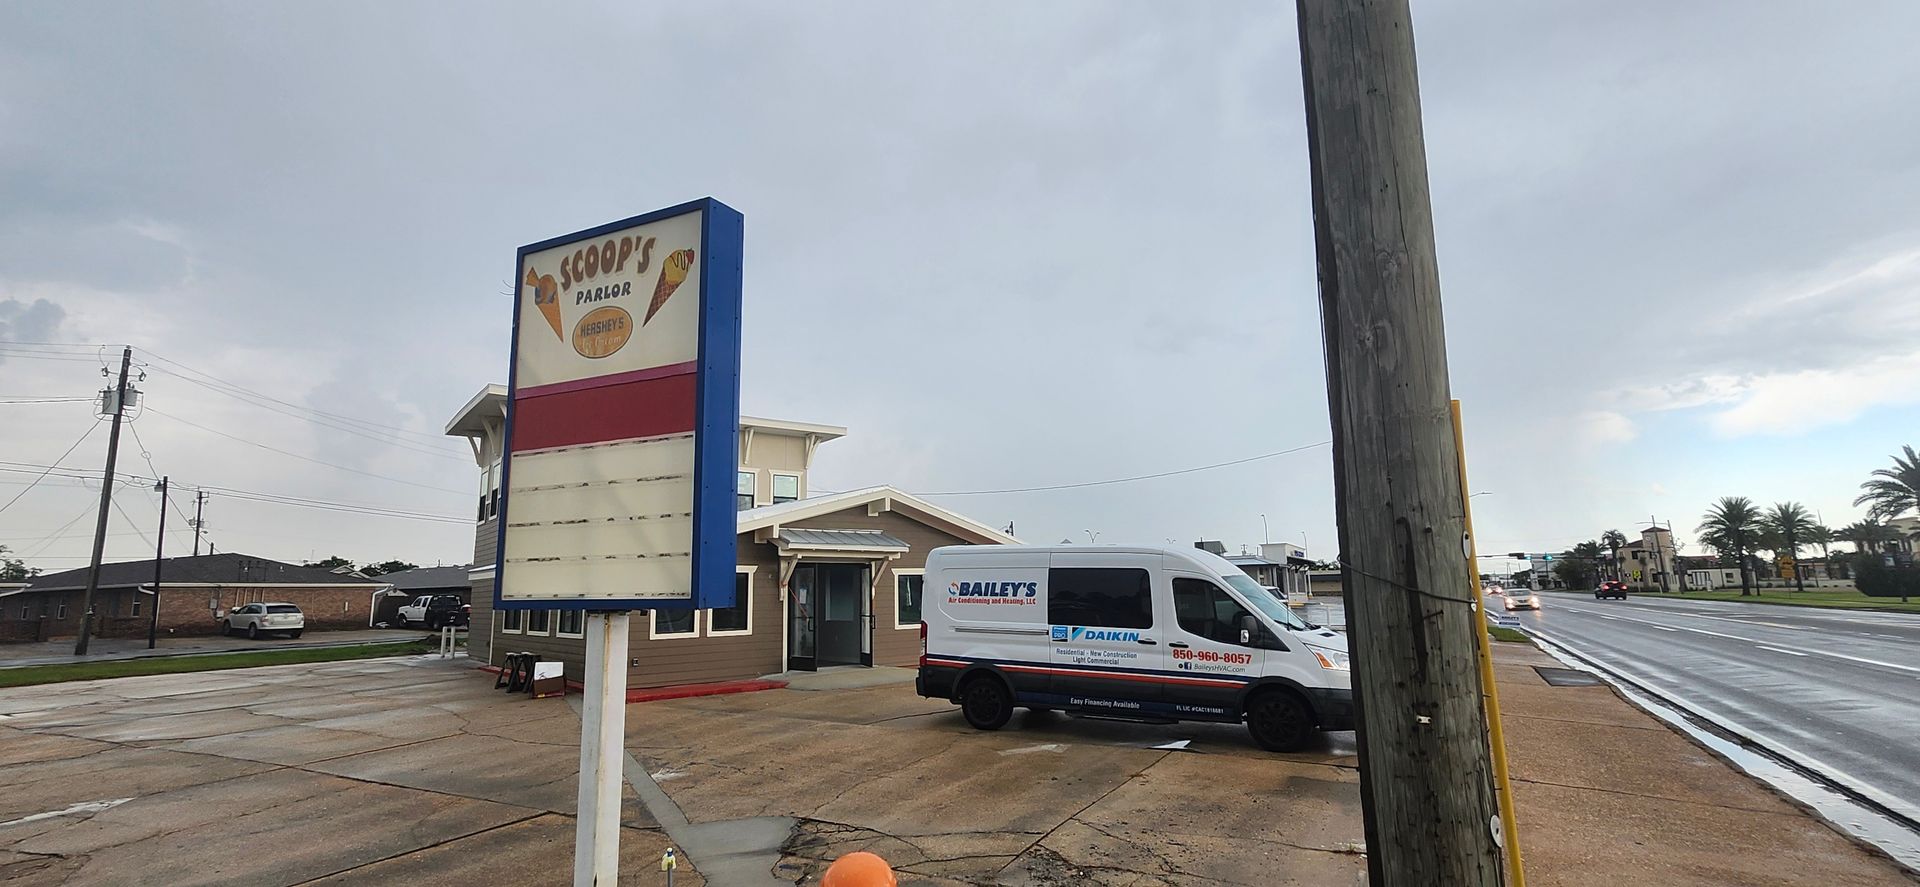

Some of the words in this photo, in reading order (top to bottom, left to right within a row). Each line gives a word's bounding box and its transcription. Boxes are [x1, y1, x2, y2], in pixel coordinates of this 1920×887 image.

[560, 236, 656, 292] SCOOP'S
[576, 281, 631, 305] PARLOR
[580, 316, 624, 337] HERSHEYS
[959, 582, 1037, 597] BAILEY'S
[1085, 631, 1139, 641] DAIKIN
[1056, 648, 1086, 657] Residential
[1103, 650, 1137, 659] Construction
[1072, 656, 1086, 664] Light
[1173, 649, 1252, 665] 850-960-8057
[1194, 663, 1246, 673] BaileysHVAC.com
[1070, 697, 1084, 705] Easy
[1084, 698, 1112, 708] Financing
[1112, 700, 1140, 709] Available
